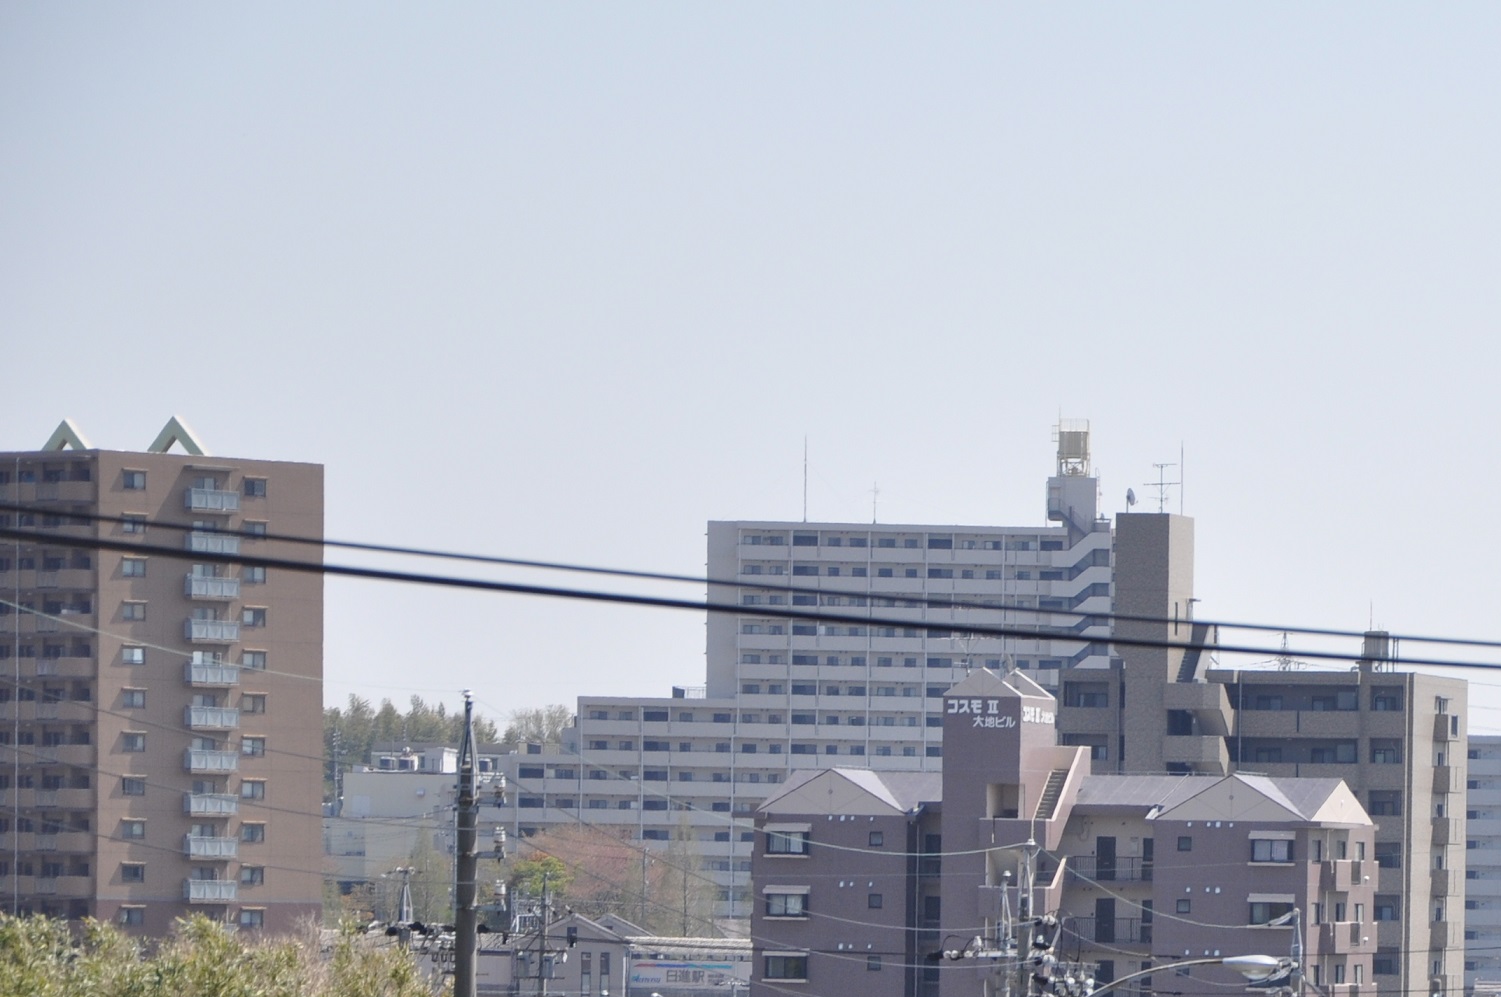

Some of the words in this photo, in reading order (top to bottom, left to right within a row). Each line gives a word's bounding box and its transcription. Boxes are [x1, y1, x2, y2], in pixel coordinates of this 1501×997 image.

[947, 699, 982, 714] コスモ
[972, 716, 1016, 728] 大地ビル
